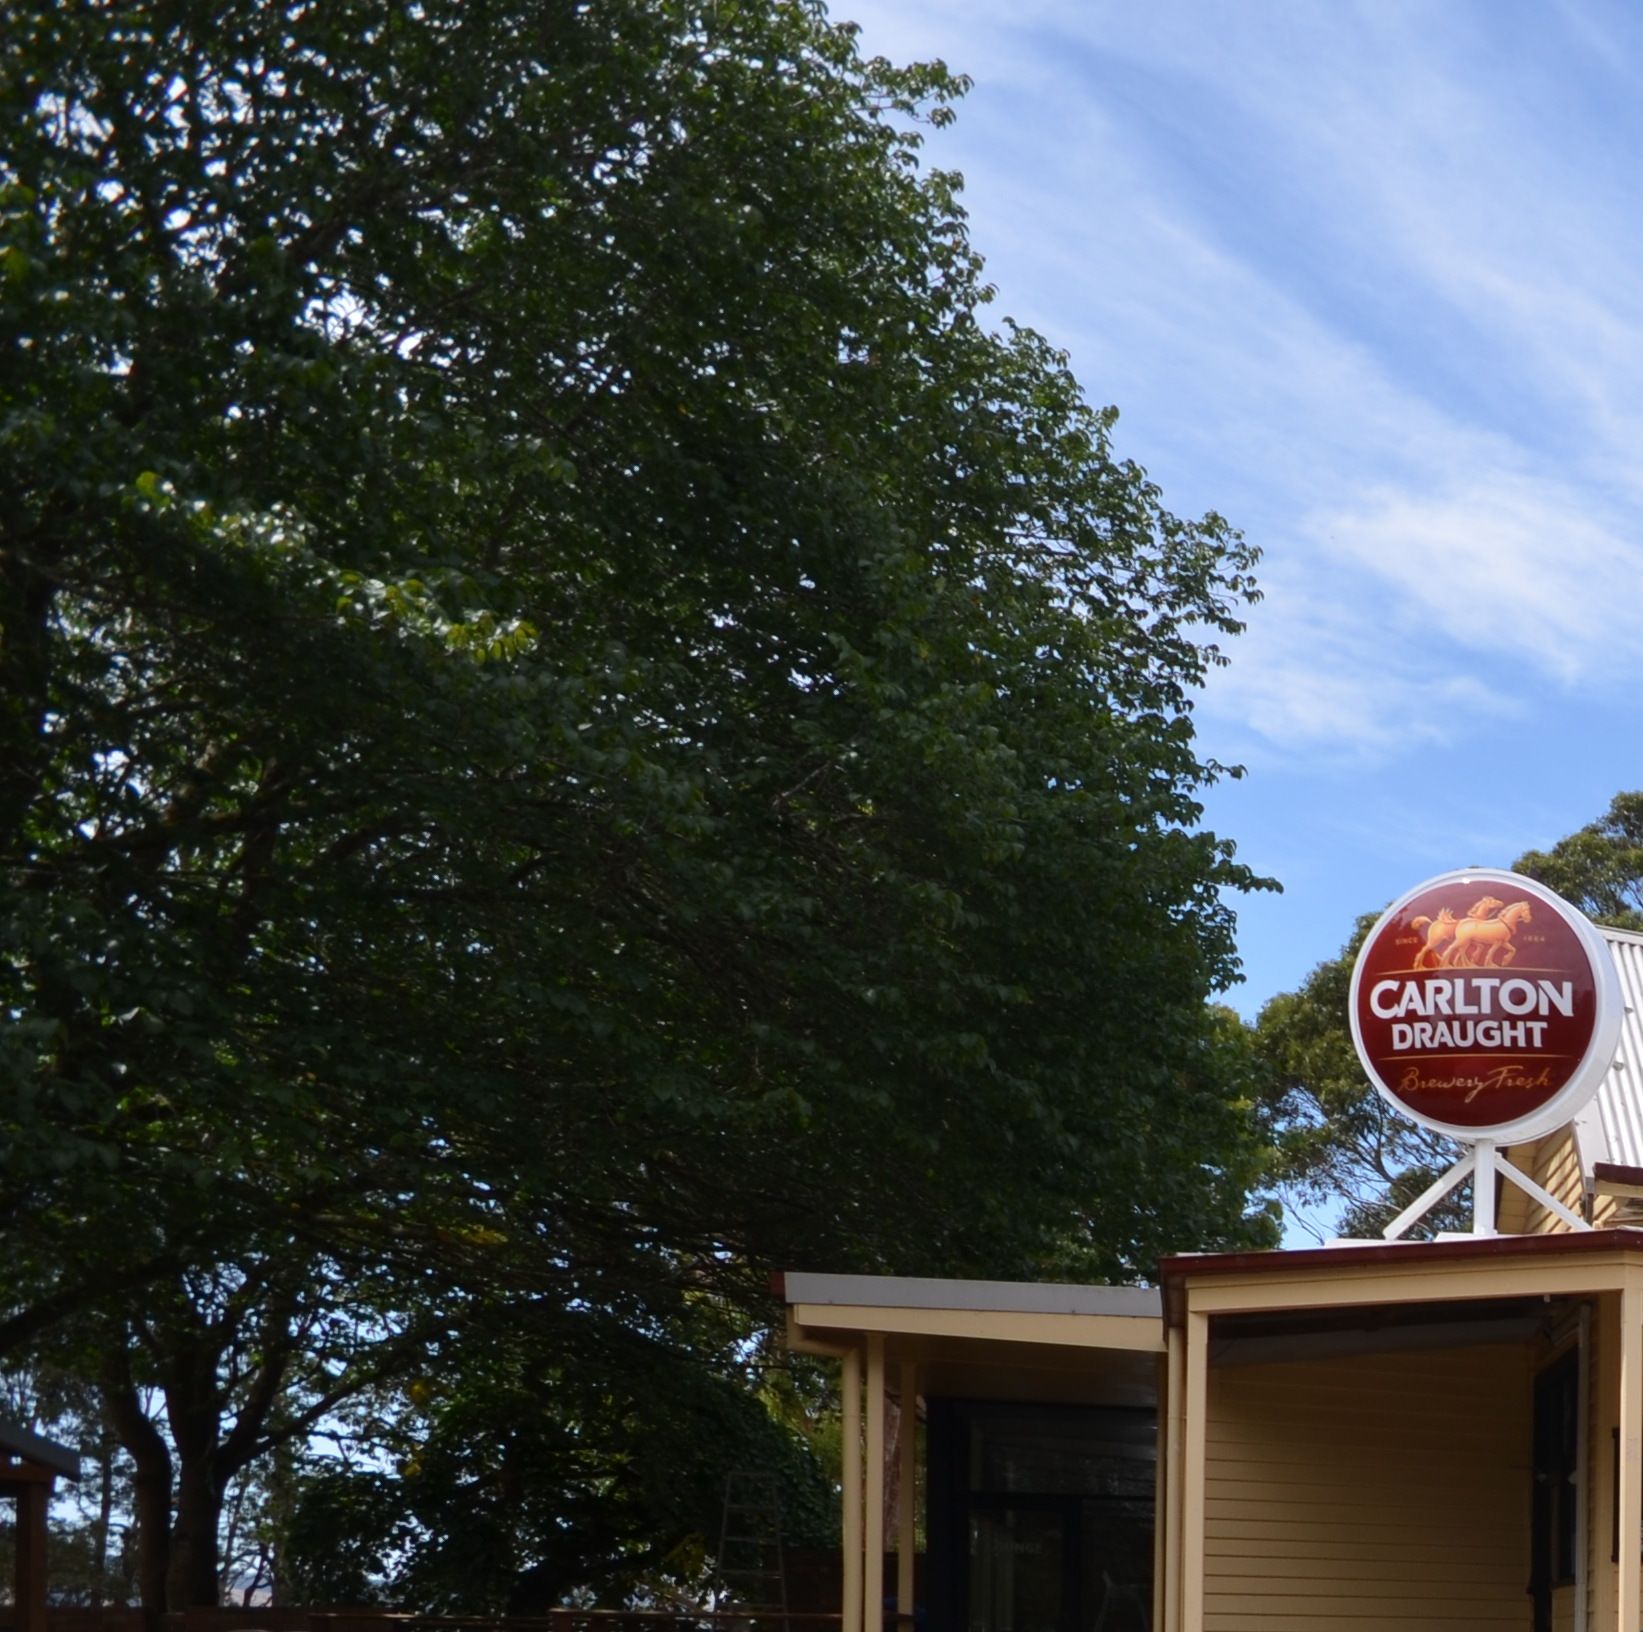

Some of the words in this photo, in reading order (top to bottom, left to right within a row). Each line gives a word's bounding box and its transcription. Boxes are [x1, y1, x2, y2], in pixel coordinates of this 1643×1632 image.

[1370, 978, 1574, 1019] CARLTON
[1391, 1020, 1548, 1050] DRAUGHT
[1397, 1066, 1494, 1103] Brewery
[1487, 1065, 1551, 1089] Fresh
